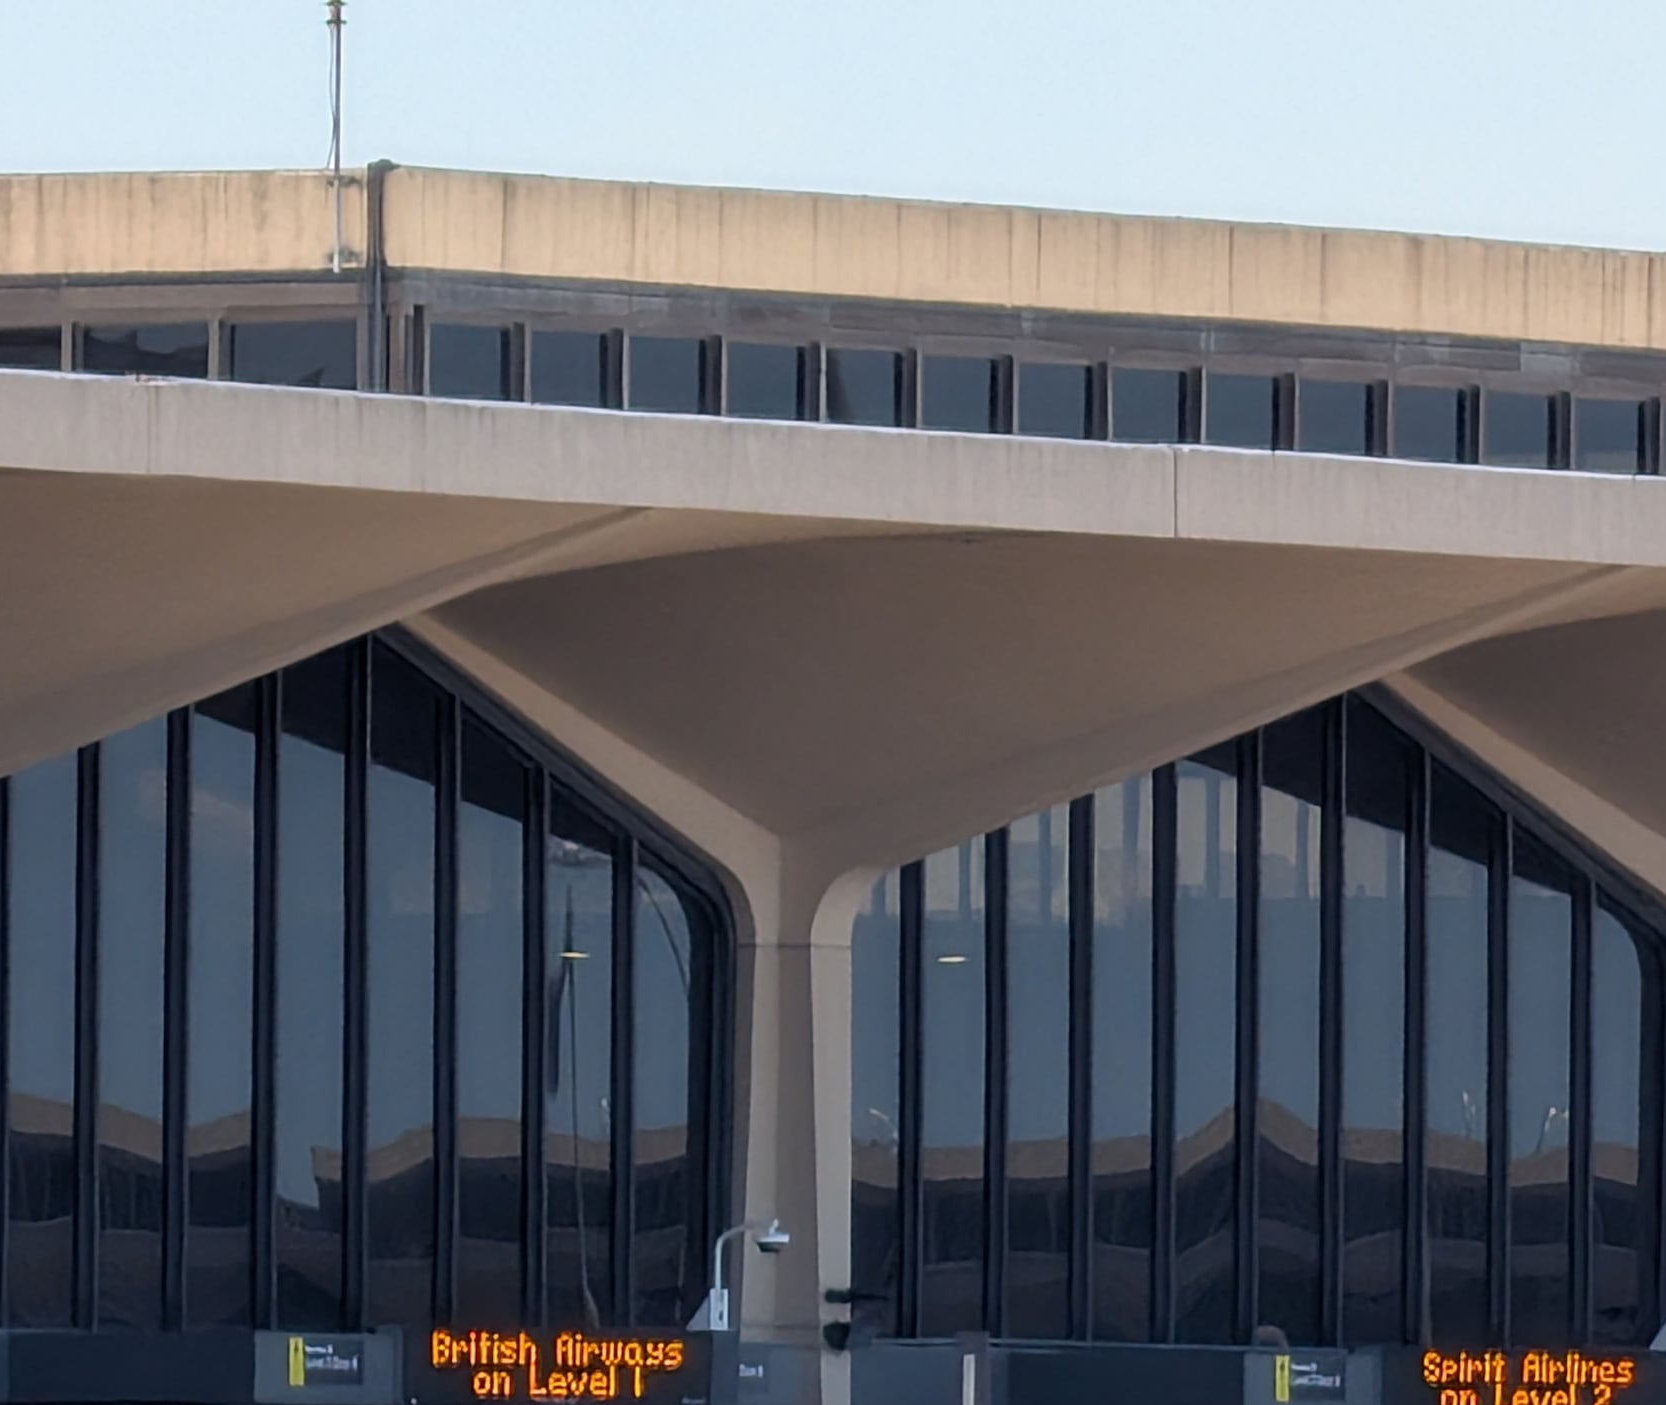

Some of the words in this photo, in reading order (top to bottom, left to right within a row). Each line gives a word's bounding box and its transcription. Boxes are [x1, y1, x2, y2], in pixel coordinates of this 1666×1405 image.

[432, 1330, 536, 1366] British
[555, 1332, 683, 1369] Airways
[473, 1371, 511, 1395] on
[529, 1365, 616, 1396] Level
[1423, 1350, 1505, 1384] Spirit
[1523, 1351, 1634, 1384] Airlines
